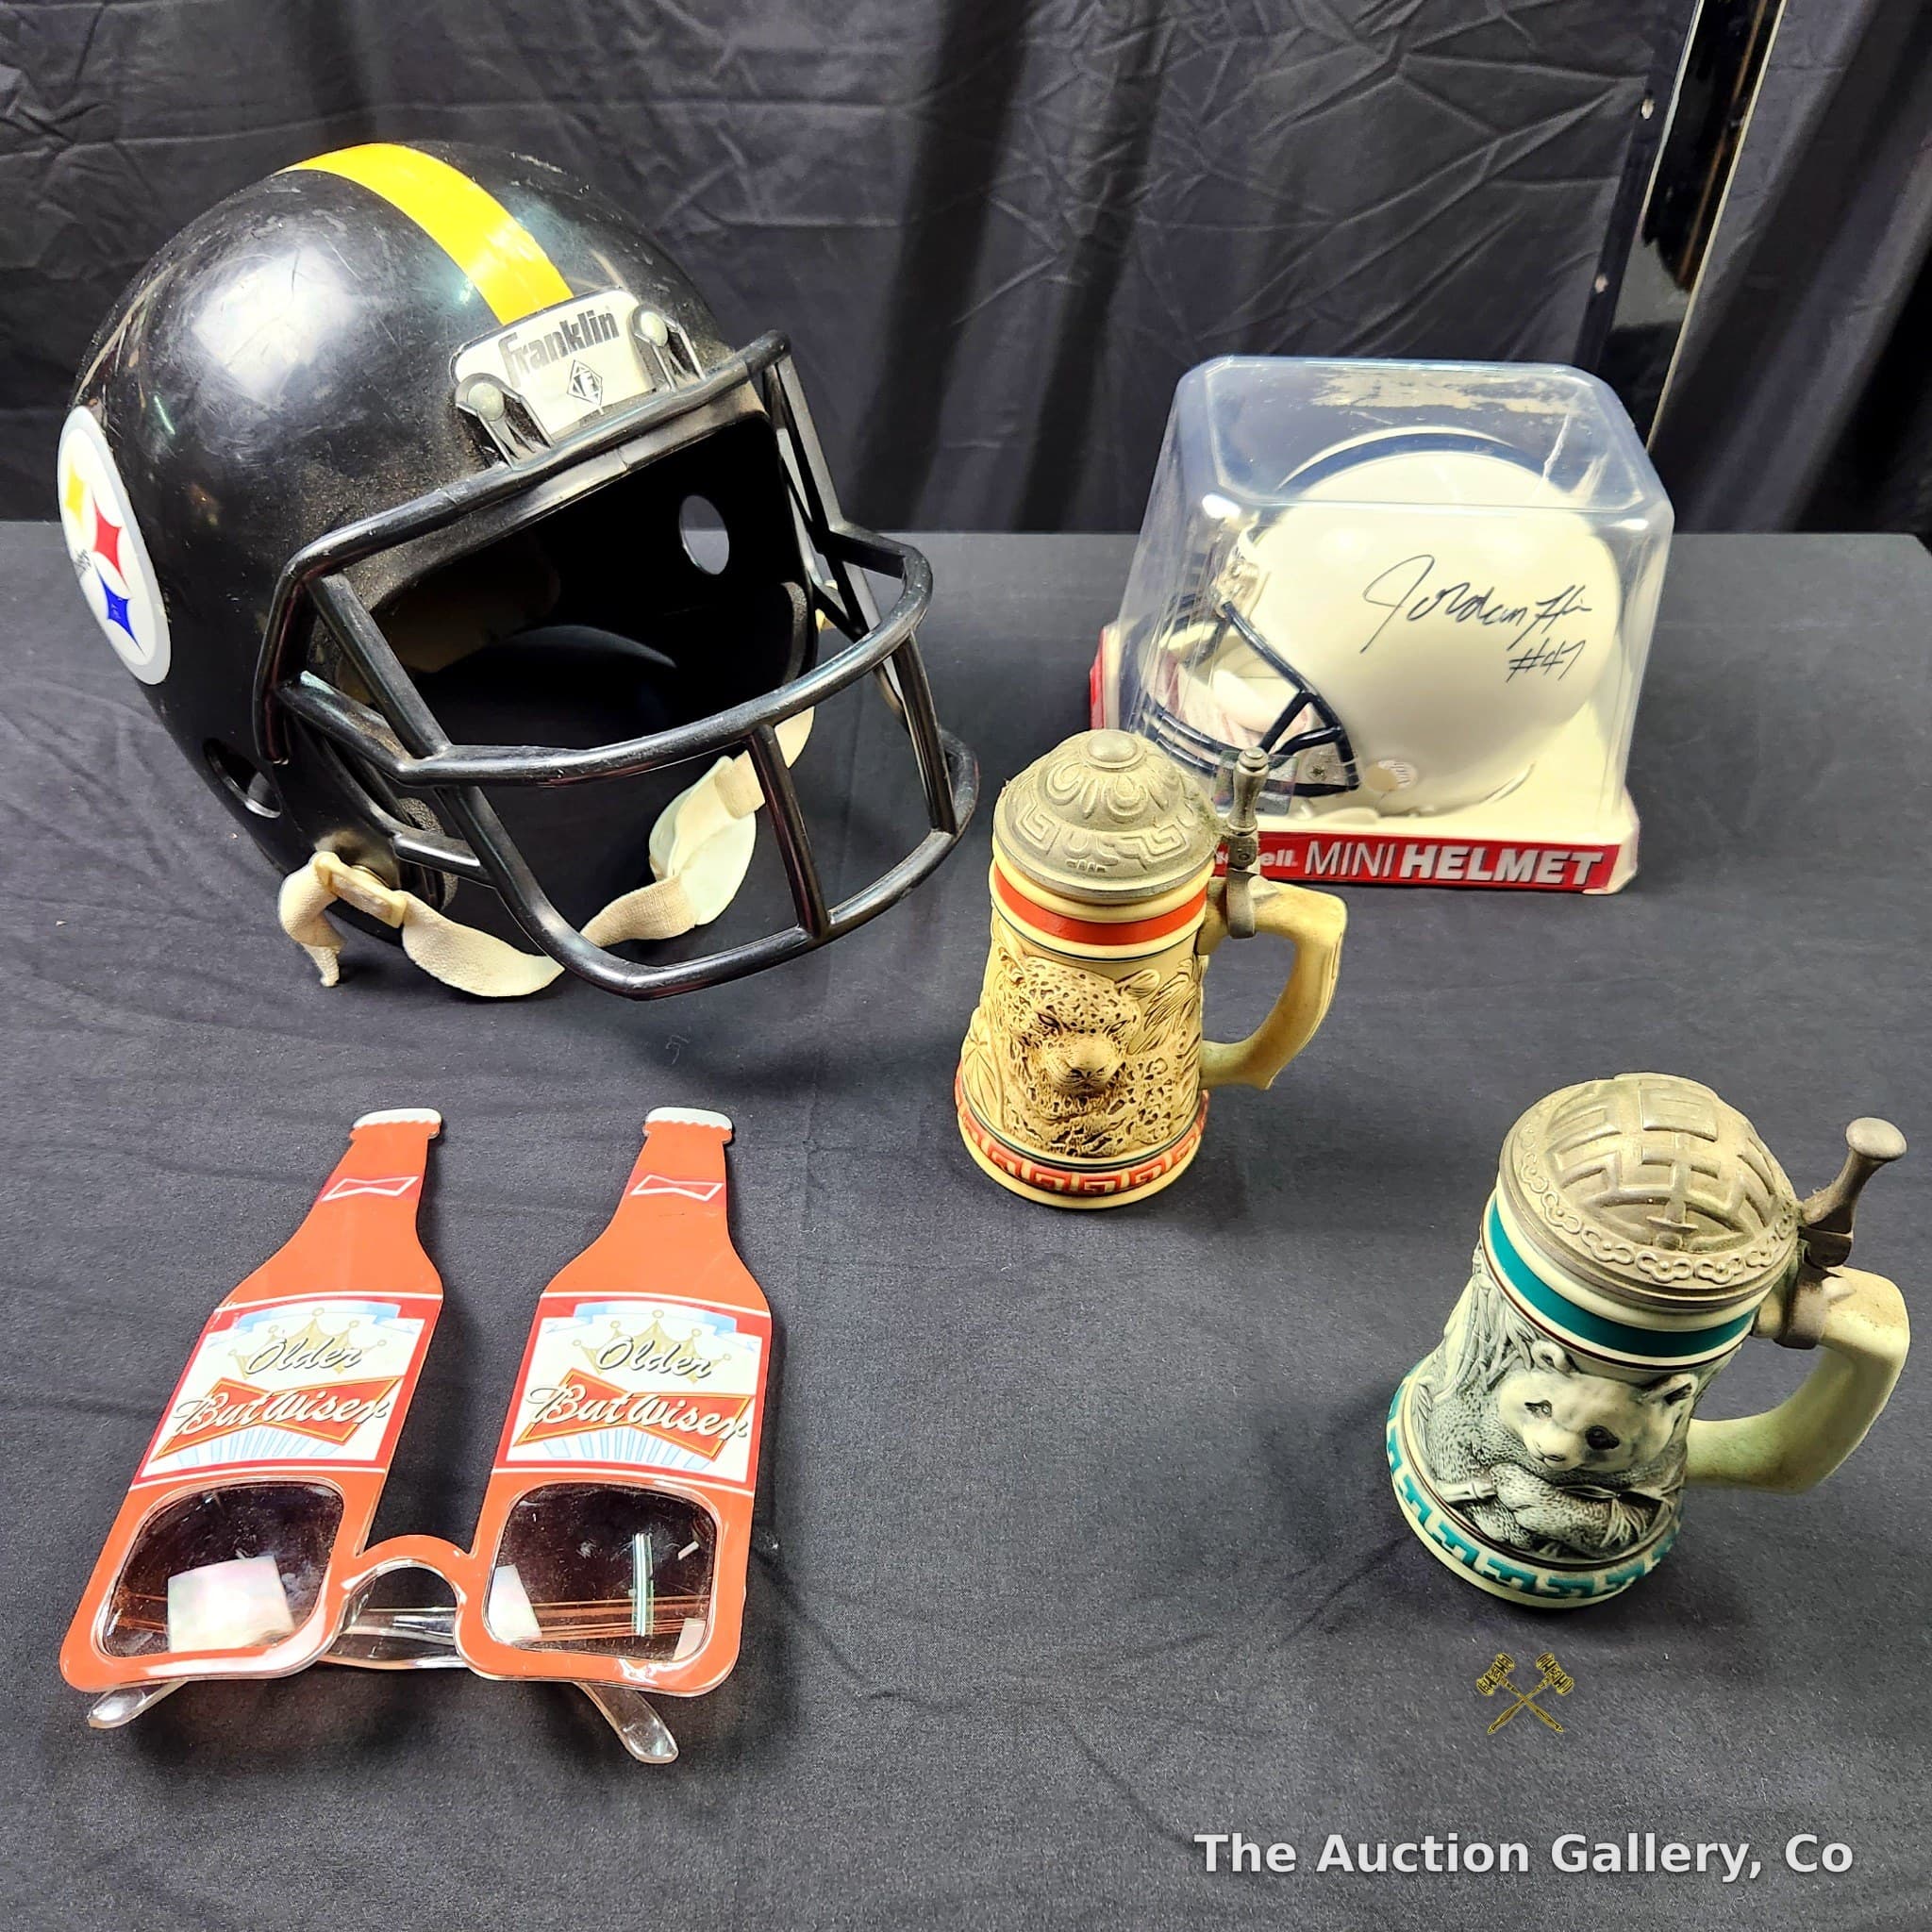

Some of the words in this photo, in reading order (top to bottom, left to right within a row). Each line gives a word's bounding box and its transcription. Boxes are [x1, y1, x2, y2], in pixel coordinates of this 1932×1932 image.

[498, 309, 620, 389] Franklin
[1507, 638, 1586, 682] #47
[1305, 841, 1395, 877] MINI
[1399, 844, 1603, 885] HELMET
[246, 1337, 363, 1375] Older
[595, 1335, 713, 1378] Older
